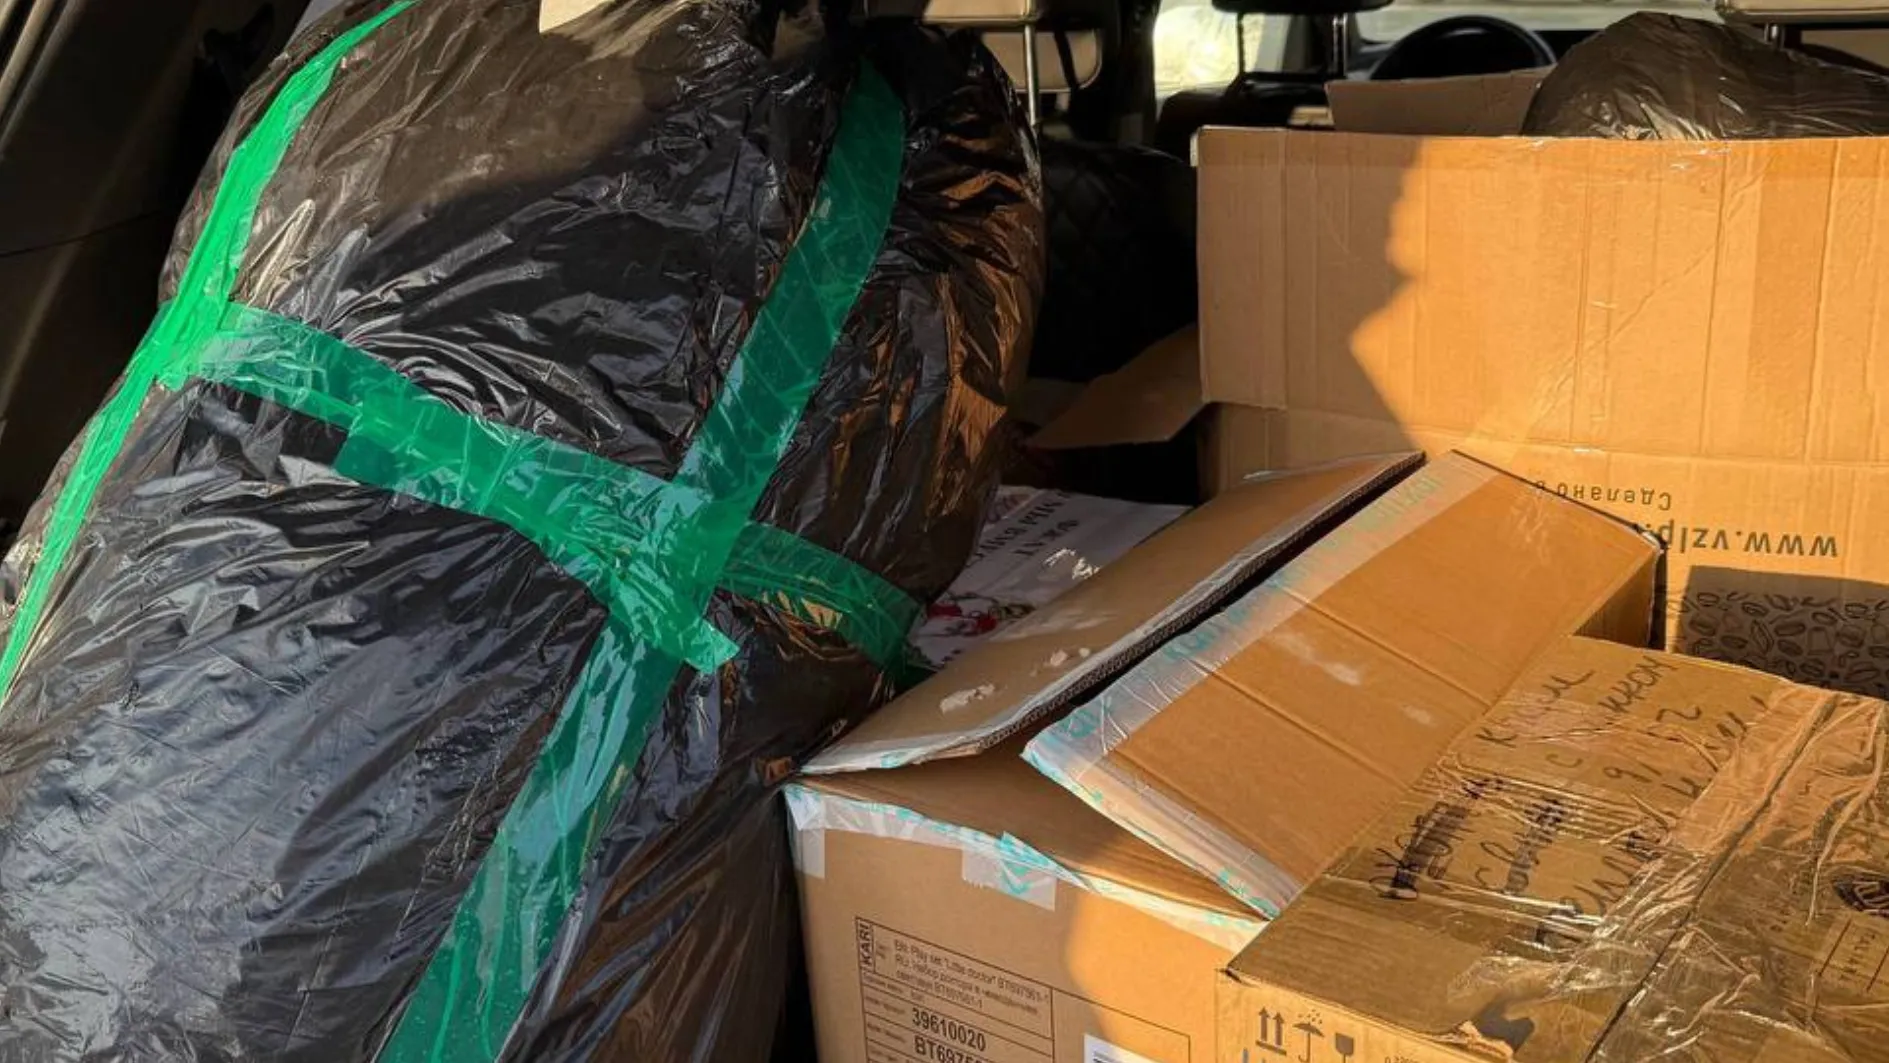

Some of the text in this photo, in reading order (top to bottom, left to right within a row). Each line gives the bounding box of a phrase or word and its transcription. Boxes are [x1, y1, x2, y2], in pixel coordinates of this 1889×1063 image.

[1556, 481, 1673, 511] Сделано
[859, 923, 873, 967] KARI
[911, 1007, 987, 1052] 39610020
[913, 1034, 983, 1063] BT6975
